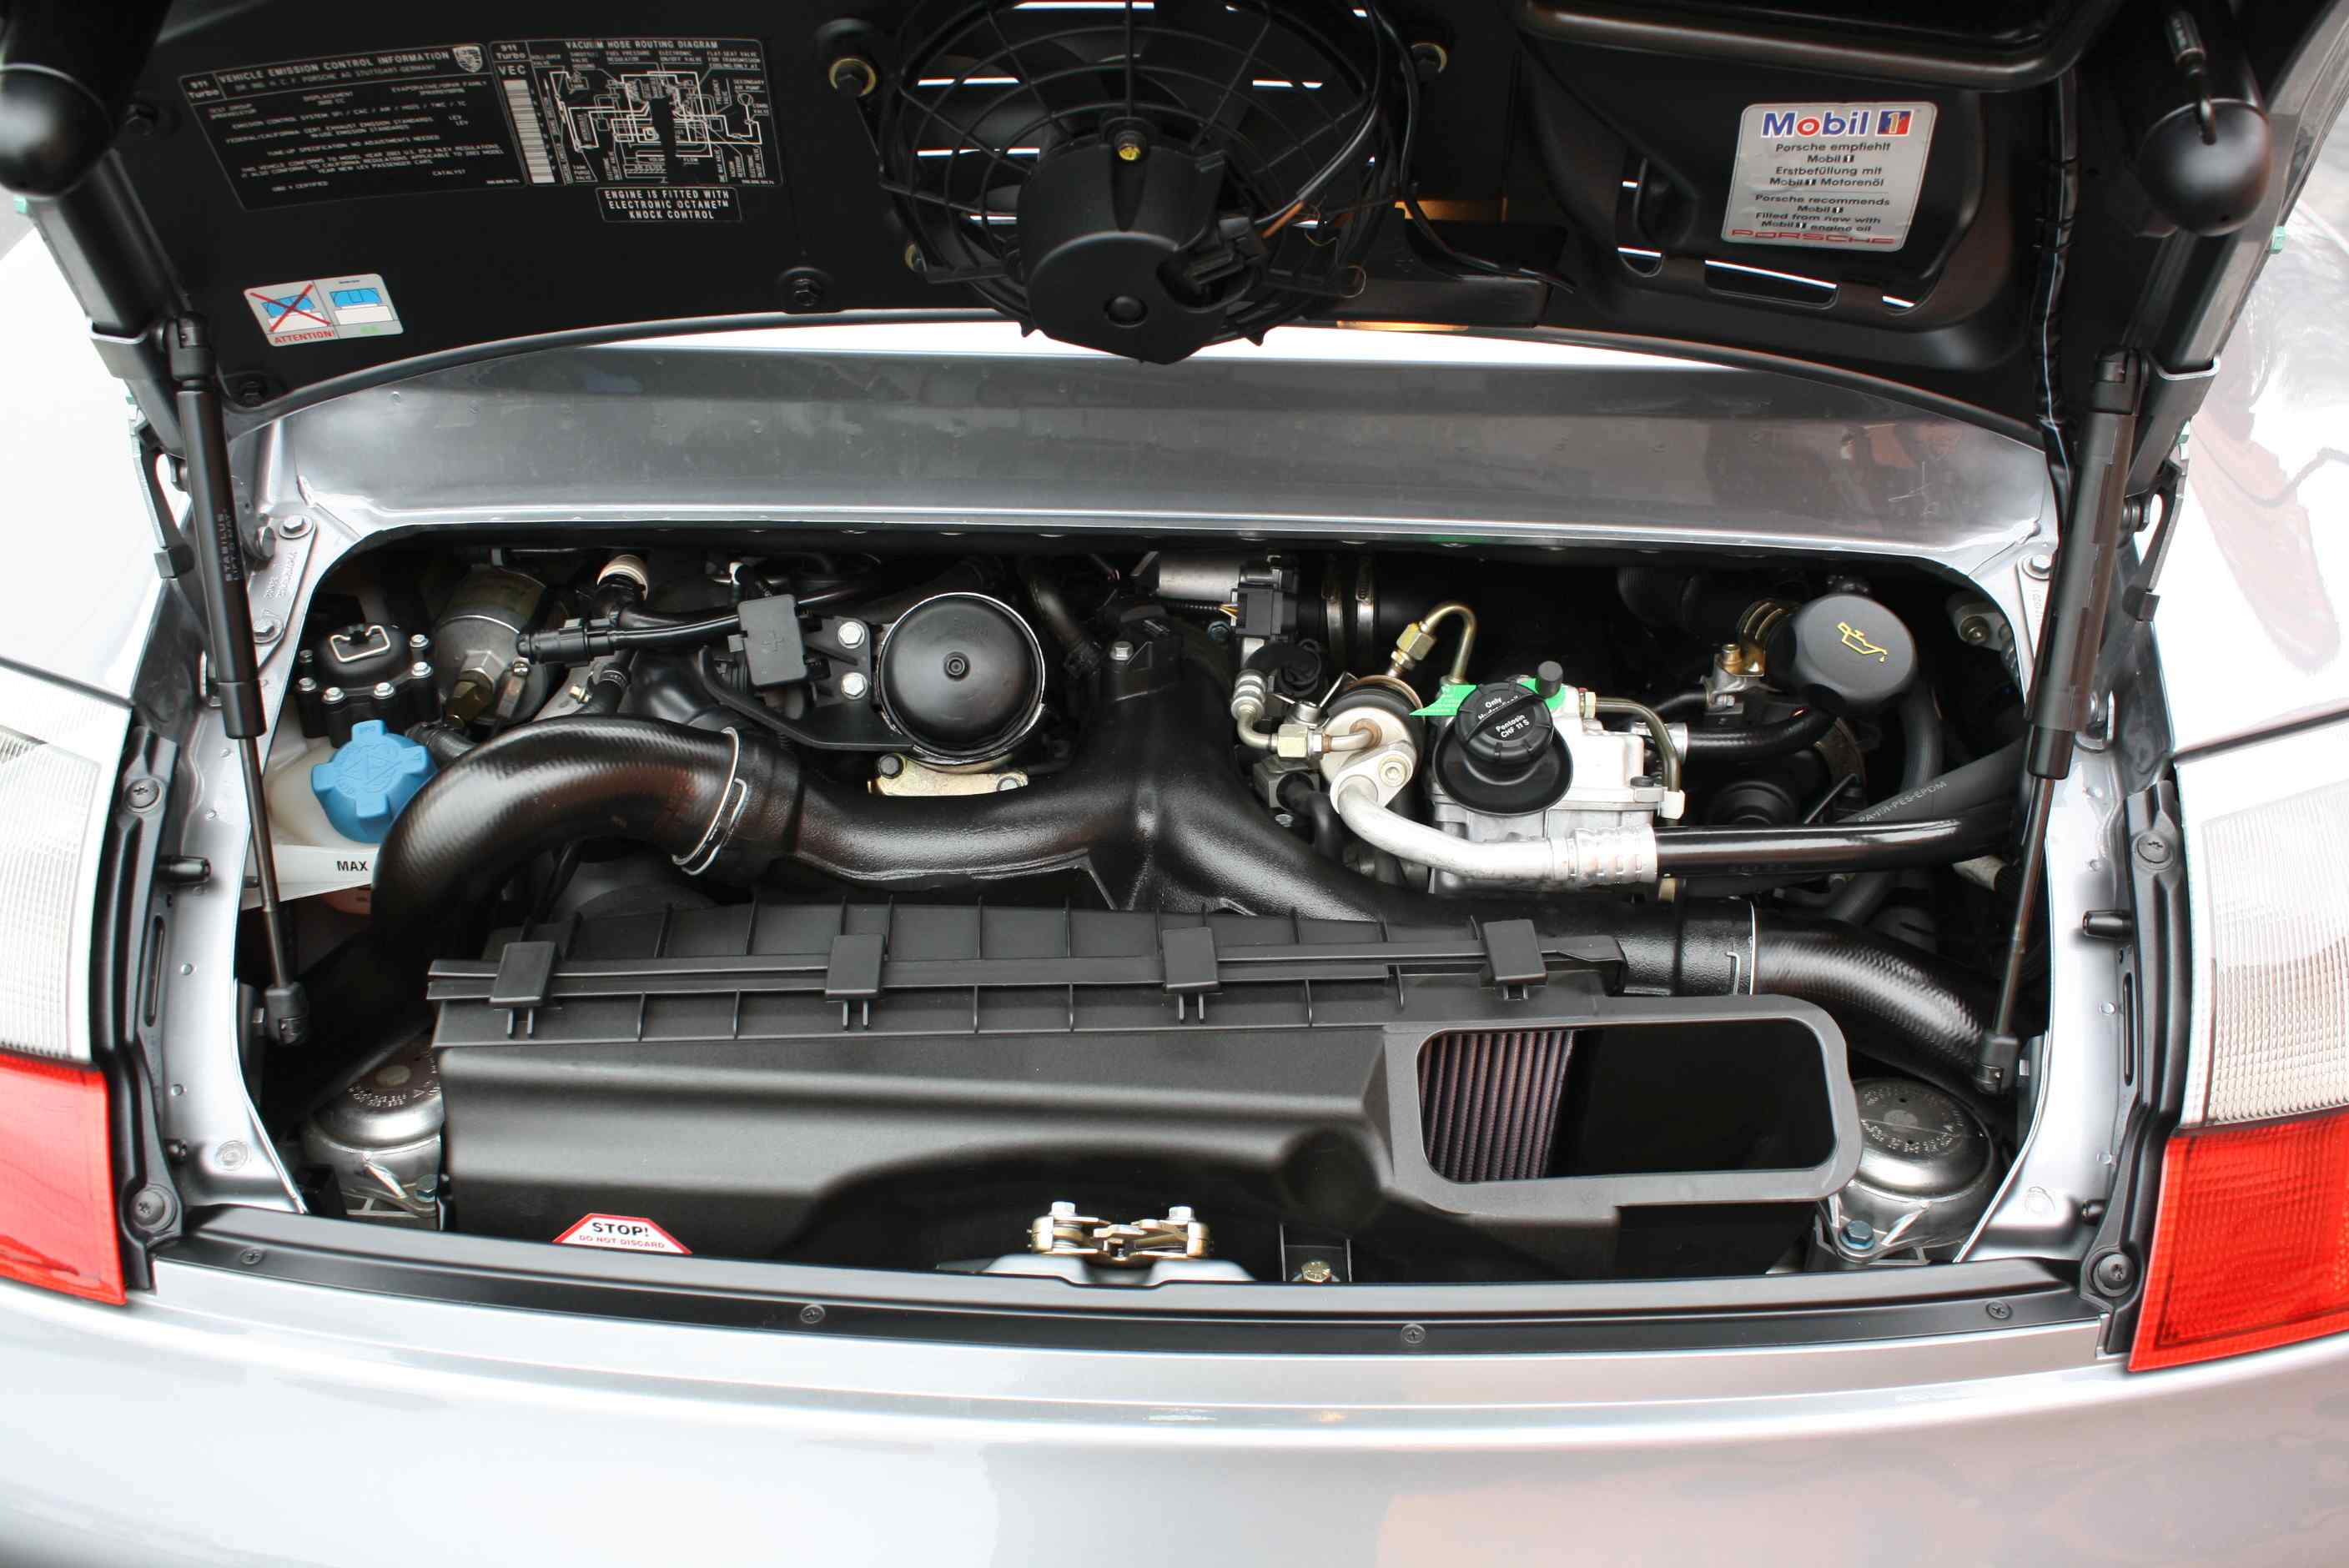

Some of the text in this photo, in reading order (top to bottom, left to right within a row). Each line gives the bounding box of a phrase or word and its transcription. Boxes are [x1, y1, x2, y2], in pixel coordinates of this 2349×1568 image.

[566, 40, 605, 49] VACUUM
[607, 40, 631, 48] HOSE
[219, 70, 264, 83] VEHICLE
[268, 63, 319, 77] EMISSION
[323, 58, 375, 70] CONTROL
[377, 51, 450, 65] INFORMATION
[497, 65, 526, 76] VEC
[189, 80, 209, 89] 911
[188, 89, 219, 99] Turbo
[1762, 110, 1870, 137] Mobil
[1776, 143, 1891, 153] Porsche empfiehlt
[1807, 154, 1841, 163] Mobil
[1776, 166, 1883, 176] Erstbefüllung mit
[1769, 178, 1803, 187] Mobil
[1820, 178, 1884, 187] Motorenöl
[605, 189, 729, 199] ENGINE IS FITTED WITH
[1755, 194, 1890, 206] Porsche recommends
[608, 200, 672, 209] ELECTRONIC
[1797, 204, 1831, 213] Mobil
[628, 210, 715, 219] KNOCK CONTROL
[1756, 212, 1788, 220] Filled
[1854, 215, 1881, 224] with
[1761, 220, 1794, 229] Mobil
[1810, 223, 1852, 233] engine
[1856, 224, 1872, 232] oil
[1732, 229, 1895, 244] PORSCHE
[274, 330, 335, 344] ATTENTION!
[1485, 696, 1503, 709] Only
[1495, 714, 1526, 732] Pentosin
[1501, 726, 1516, 739] CHF
[1516, 722, 1524, 731] 11
[337, 860, 369, 872] MAX
[592, 1222, 650, 1238] STOP!
[596, 1236, 618, 1244] NOT
[621, 1239, 665, 1249] DISCARD
